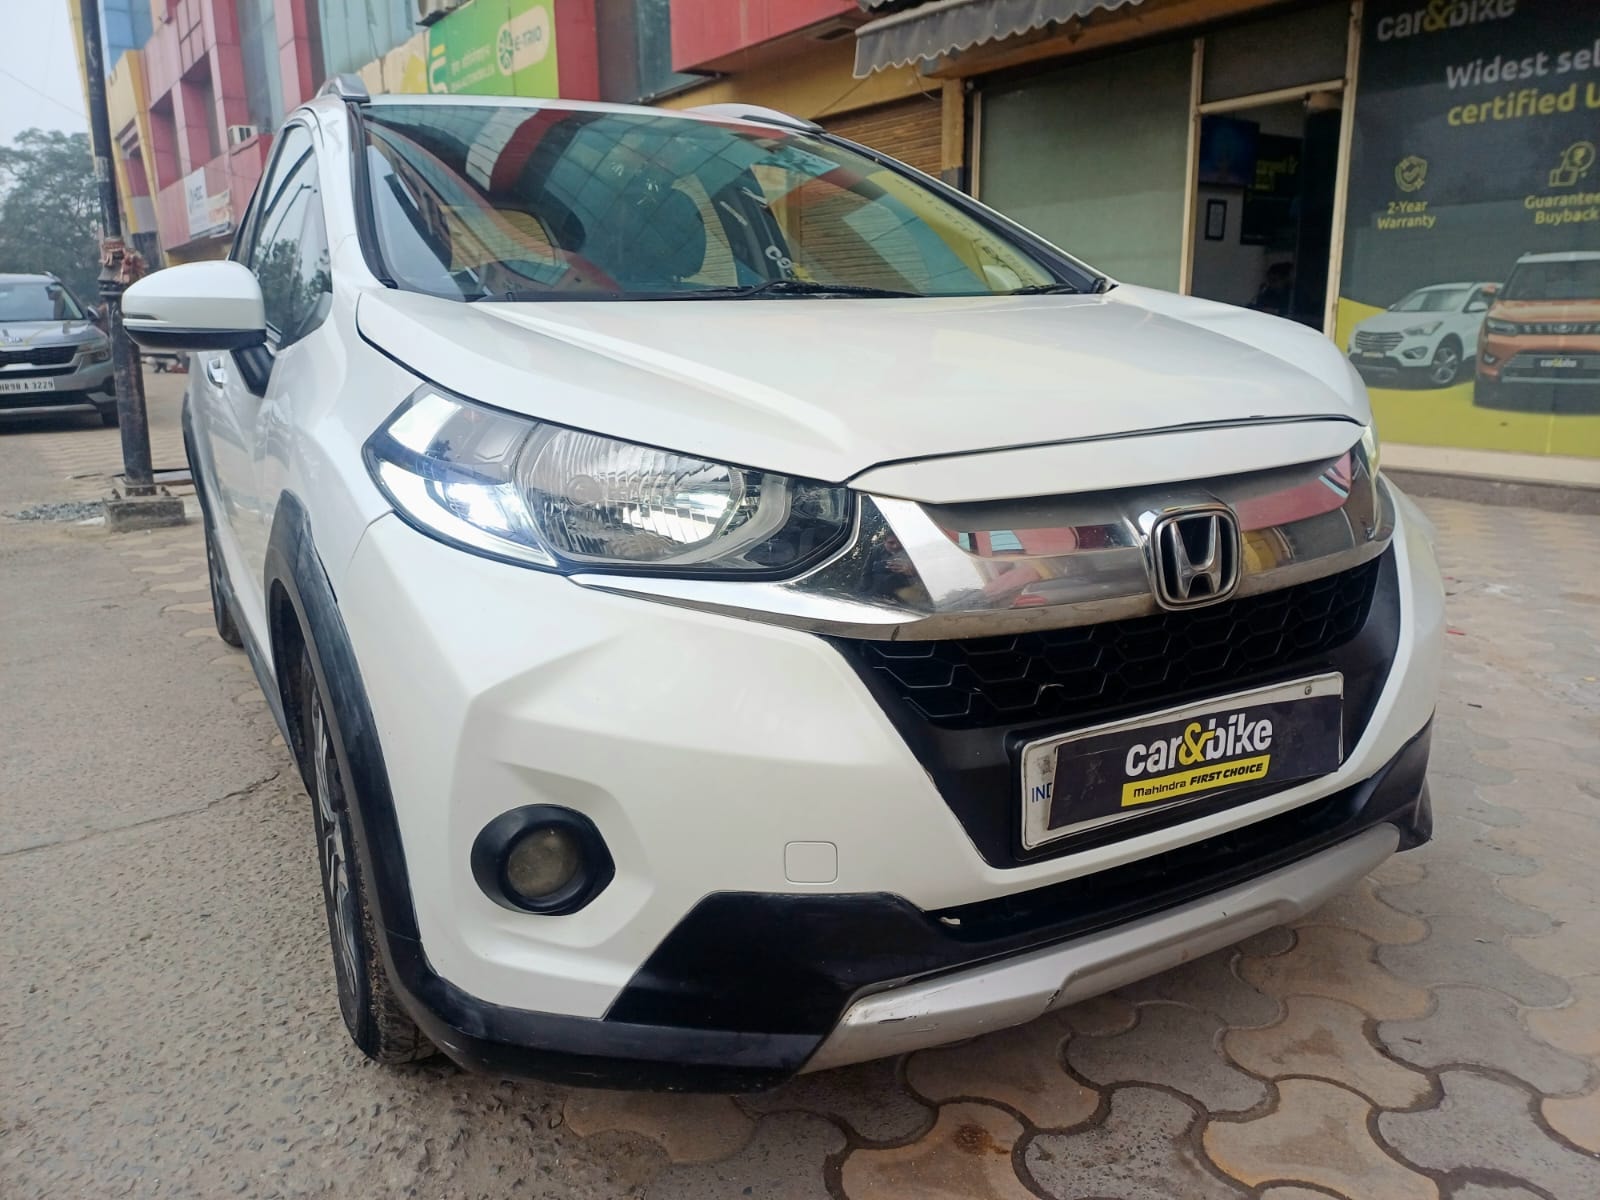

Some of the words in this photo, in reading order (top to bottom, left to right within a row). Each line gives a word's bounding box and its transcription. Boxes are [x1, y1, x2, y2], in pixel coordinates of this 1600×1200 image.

[1446, 54, 1549, 89] Widest
[1447, 83, 1577, 126] certified
[1377, 214, 1436, 230] Warranty
[1387, 201, 1428, 215] 2-Year
[1535, 207, 1599, 226] Buyback
[1124, 713, 1273, 777] car&bike
[1133, 780, 1187, 798] Mahindra
[1189, 769, 1223, 786] FIRST
[1223, 762, 1264, 779] CHOICE
